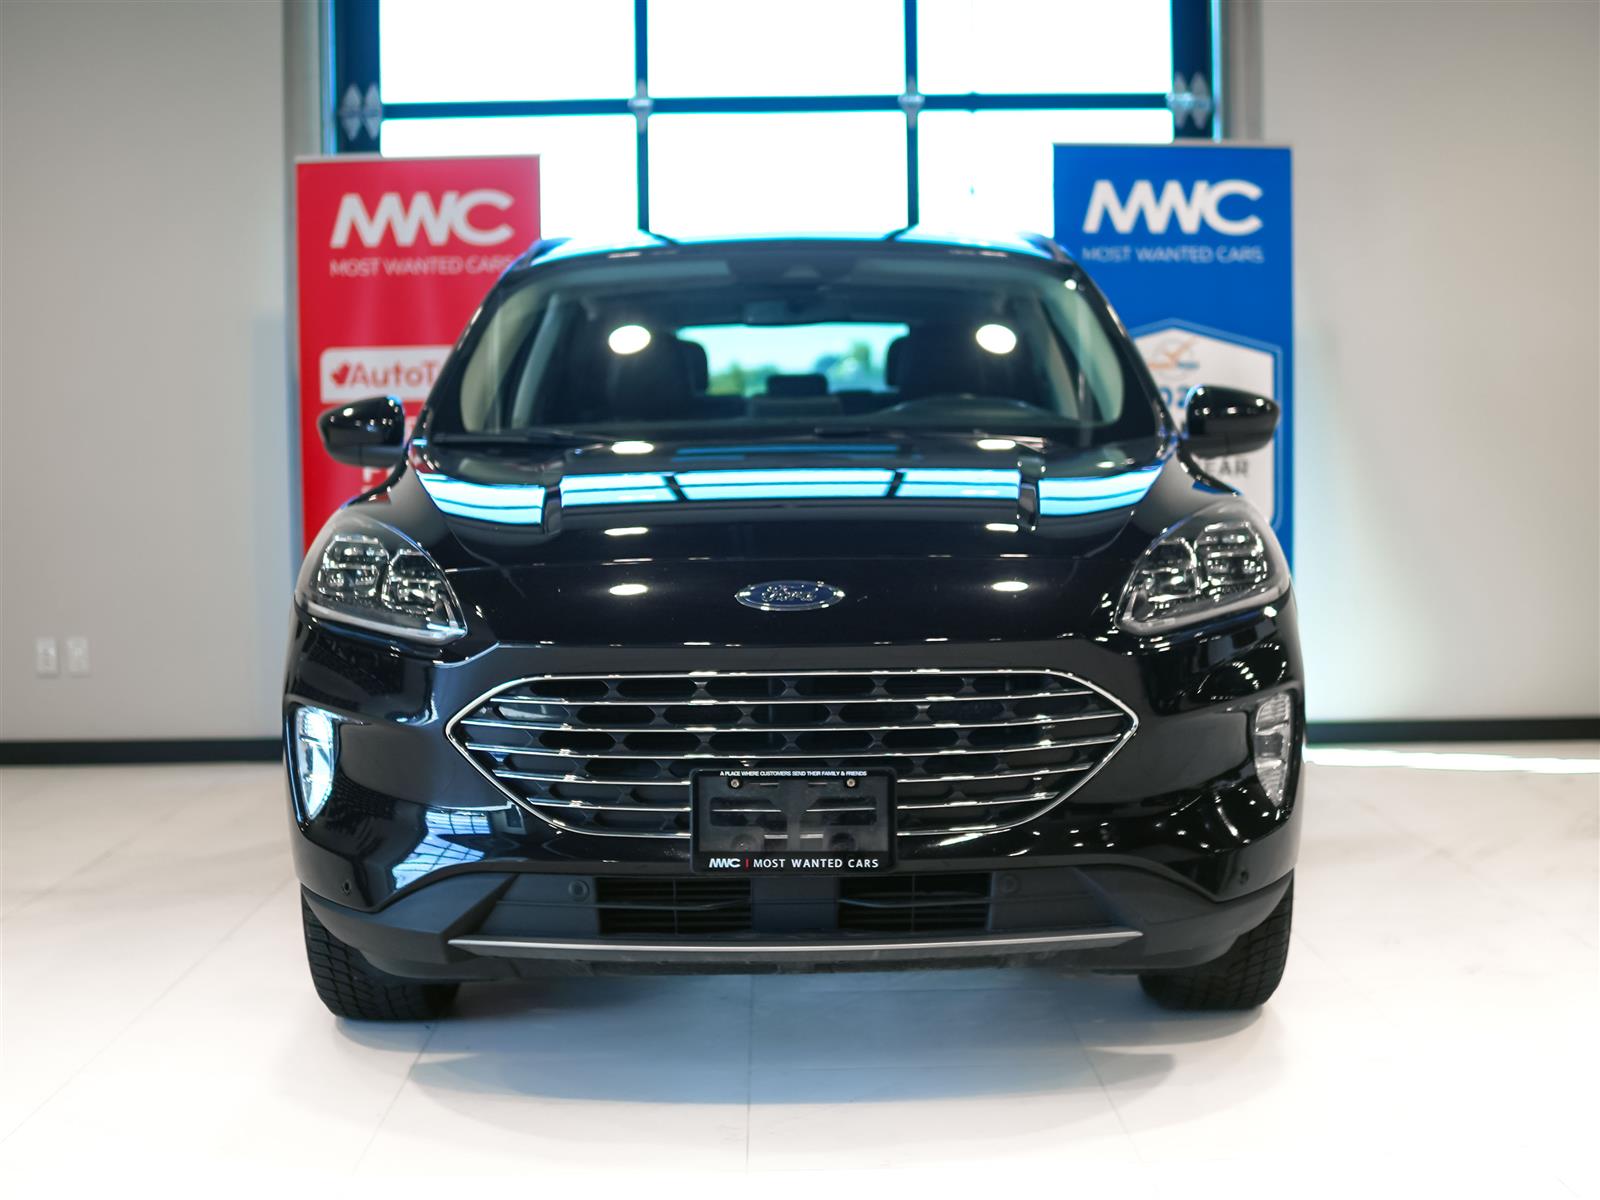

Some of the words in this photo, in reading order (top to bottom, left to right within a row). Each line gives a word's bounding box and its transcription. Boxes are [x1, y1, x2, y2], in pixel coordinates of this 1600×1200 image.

[1083, 179, 1263, 235] MWC
[330, 189, 514, 249] MWC
[1083, 245, 1131, 263] MOST
[1136, 245, 1214, 263] WANTED
[1216, 245, 1264, 264] CARS
[329, 256, 380, 278] MOST
[383, 255, 464, 276] WANTED
[350, 361, 438, 388] AutoT
[1205, 458, 1249, 477] EAR
[761, 584, 818, 603] Ford
[709, 858, 740, 868] MWC
[753, 858, 785, 868] MOST
[791, 858, 843, 868] WANTED
[847, 858, 879, 868] CARS
